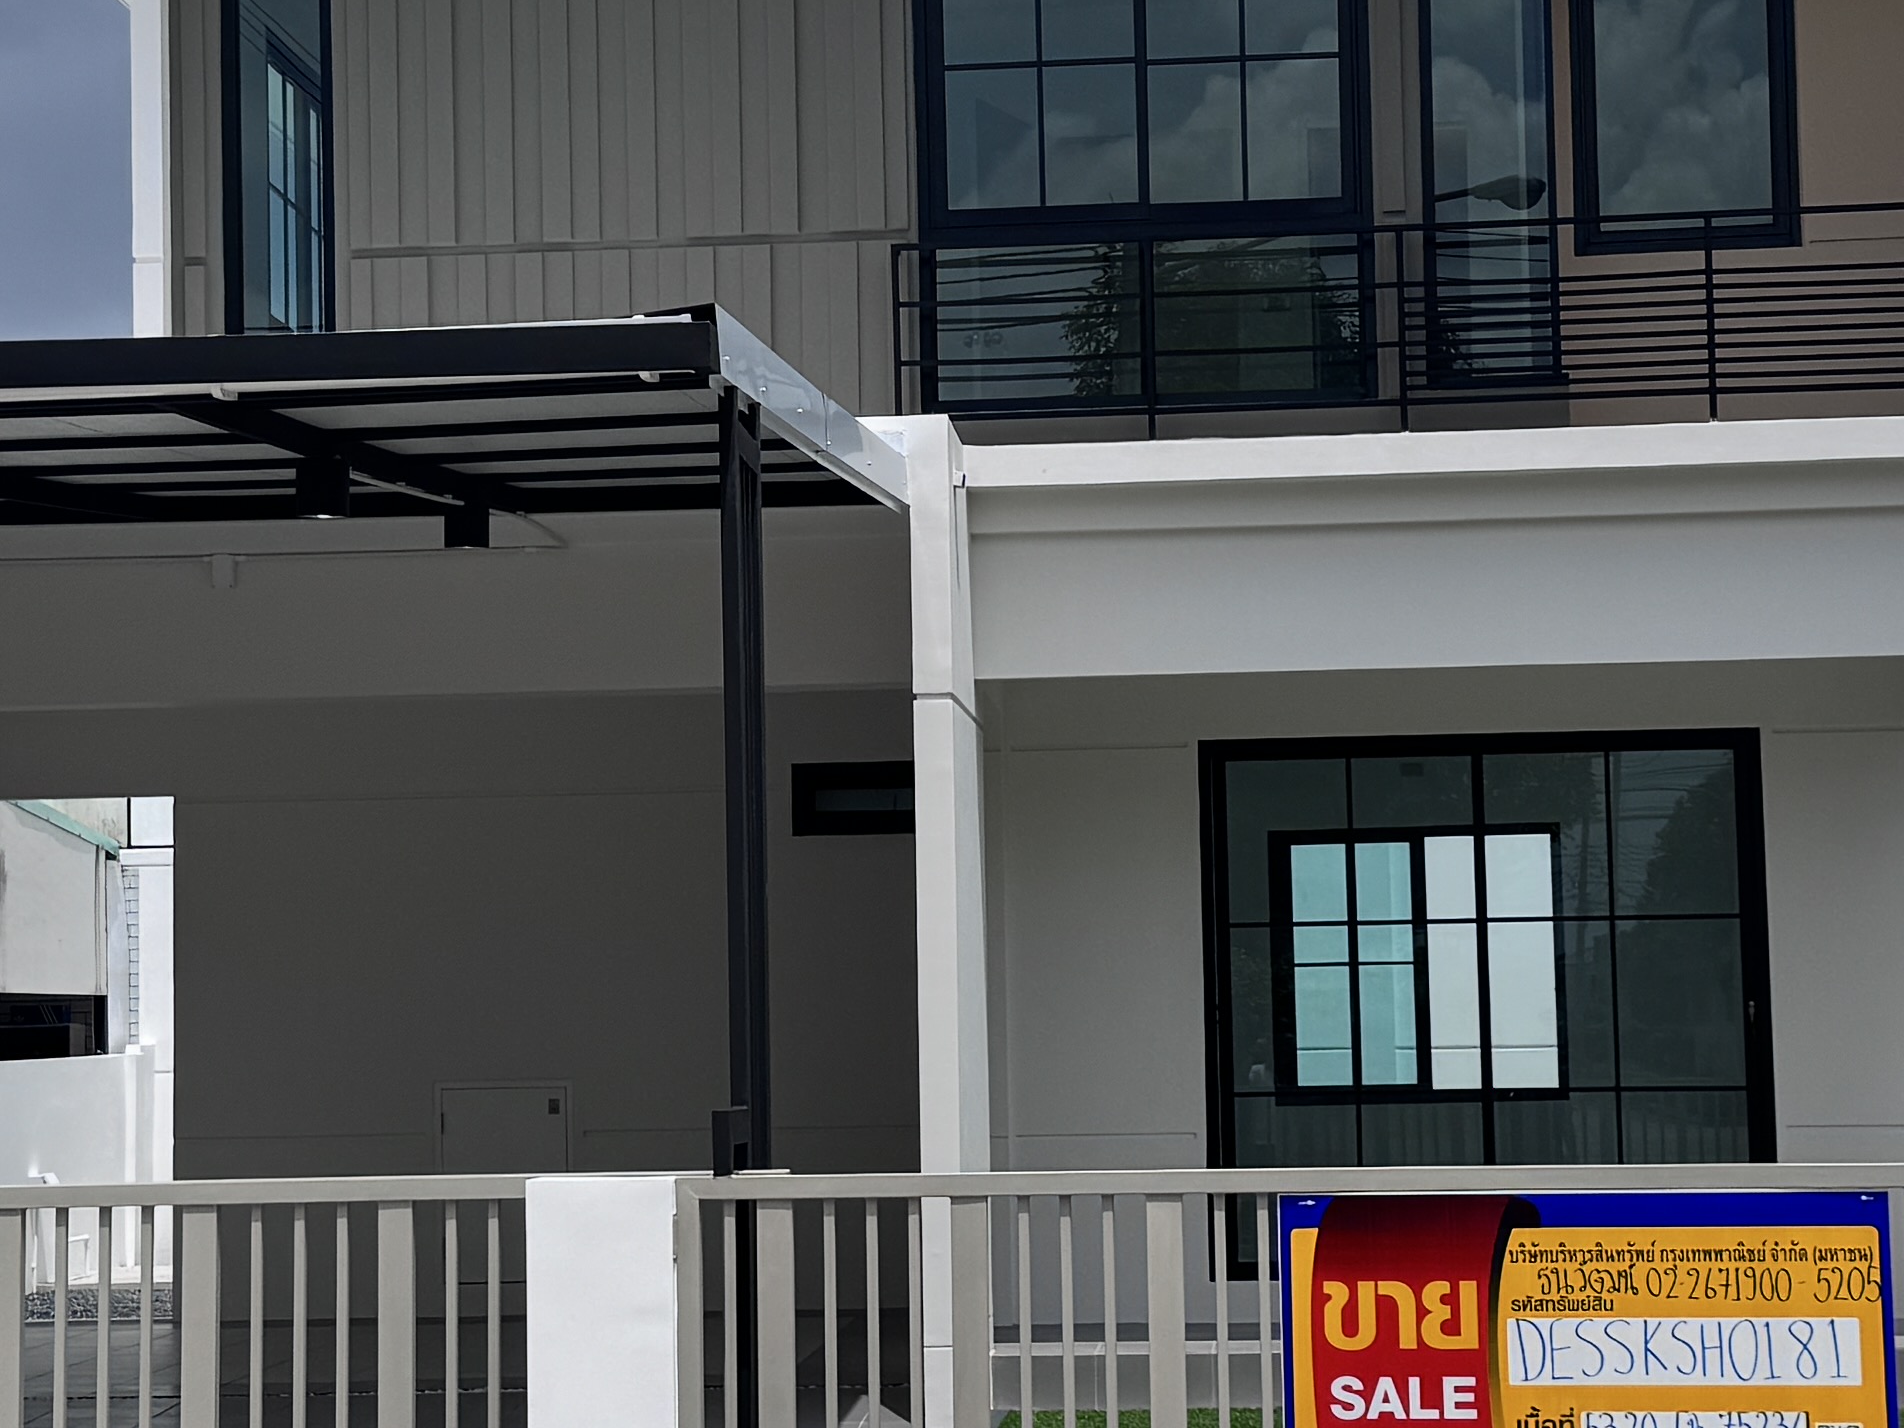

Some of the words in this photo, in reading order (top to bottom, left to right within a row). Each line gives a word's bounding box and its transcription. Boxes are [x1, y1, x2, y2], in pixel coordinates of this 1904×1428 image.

[1771, 1240, 1808, 1262] จำกัด
[1813, 1245, 1873, 1266] (มหาชน)
[1511, 1294, 1614, 1312] รหัสทรัพย์สิน
[1814, 1264, 1882, 1303] 5205
[1323, 1280, 1479, 1351] ขาย
[1330, 1375, 1478, 1420] SALE
